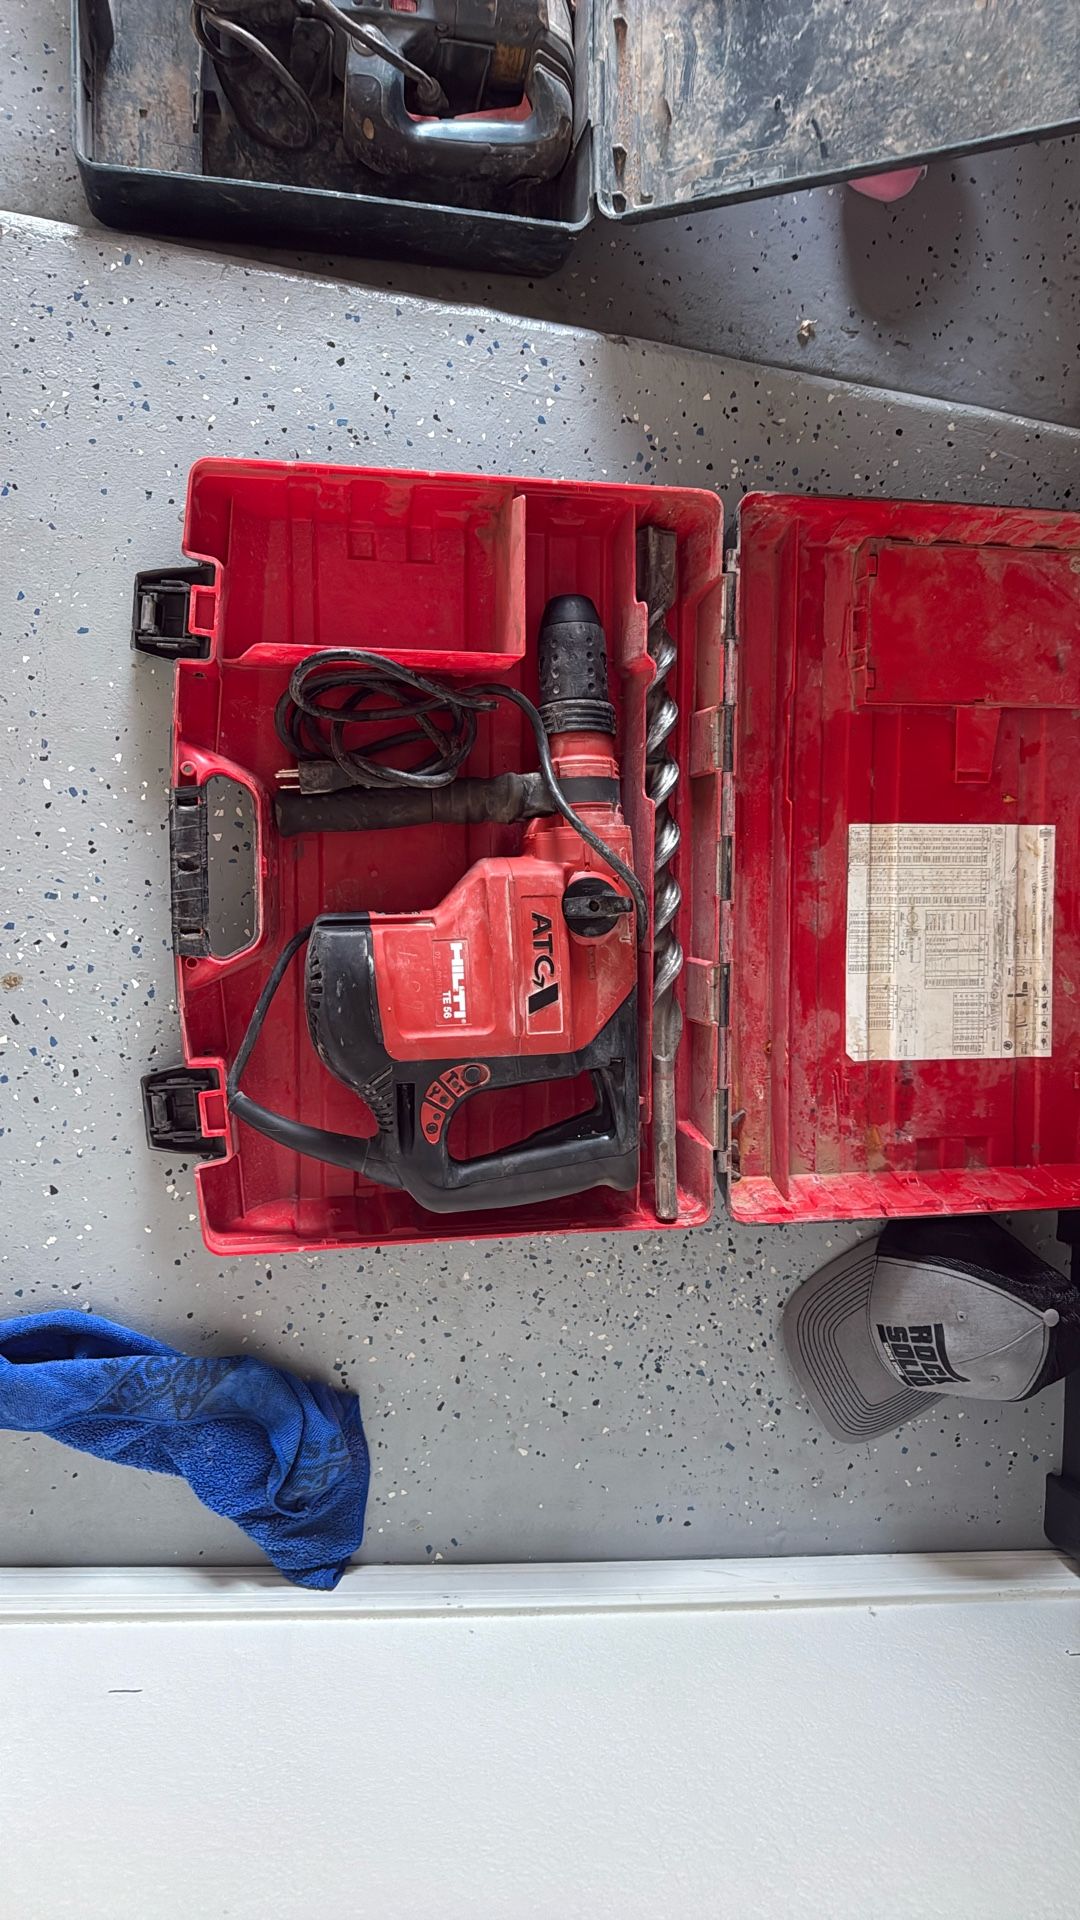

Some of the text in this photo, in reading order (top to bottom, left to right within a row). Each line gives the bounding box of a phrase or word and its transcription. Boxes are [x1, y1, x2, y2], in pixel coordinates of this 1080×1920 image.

[442, 990, 452, 1019] TE 56
[450, 942, 466, 1019] HILTI
[886, 1326, 935, 1387] SOLID
[908, 1325, 959, 1383] ROCK
